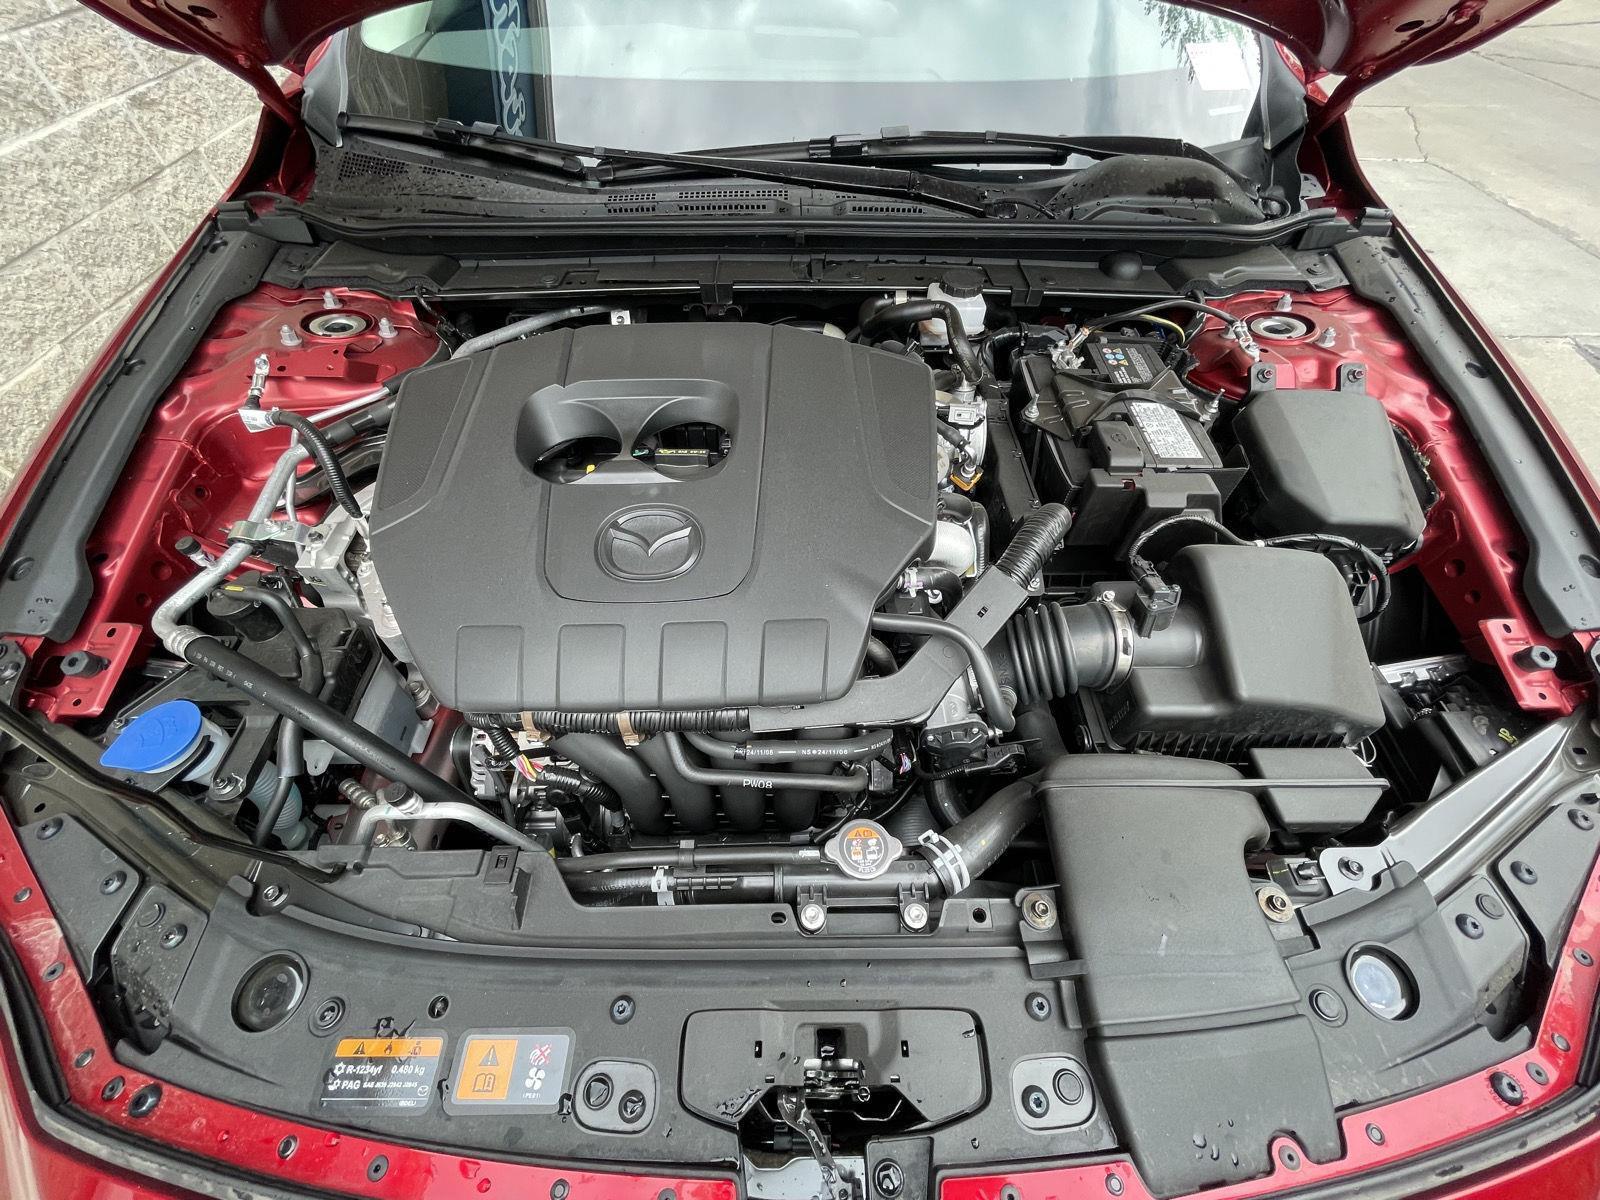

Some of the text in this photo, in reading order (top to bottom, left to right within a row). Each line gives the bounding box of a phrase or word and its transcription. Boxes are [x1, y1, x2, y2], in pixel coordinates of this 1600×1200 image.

[743, 779, 772, 789] PW08
[346, 1065, 425, 1076] R-1234yf 0.480 kg
[341, 1080, 361, 1090] PAG
